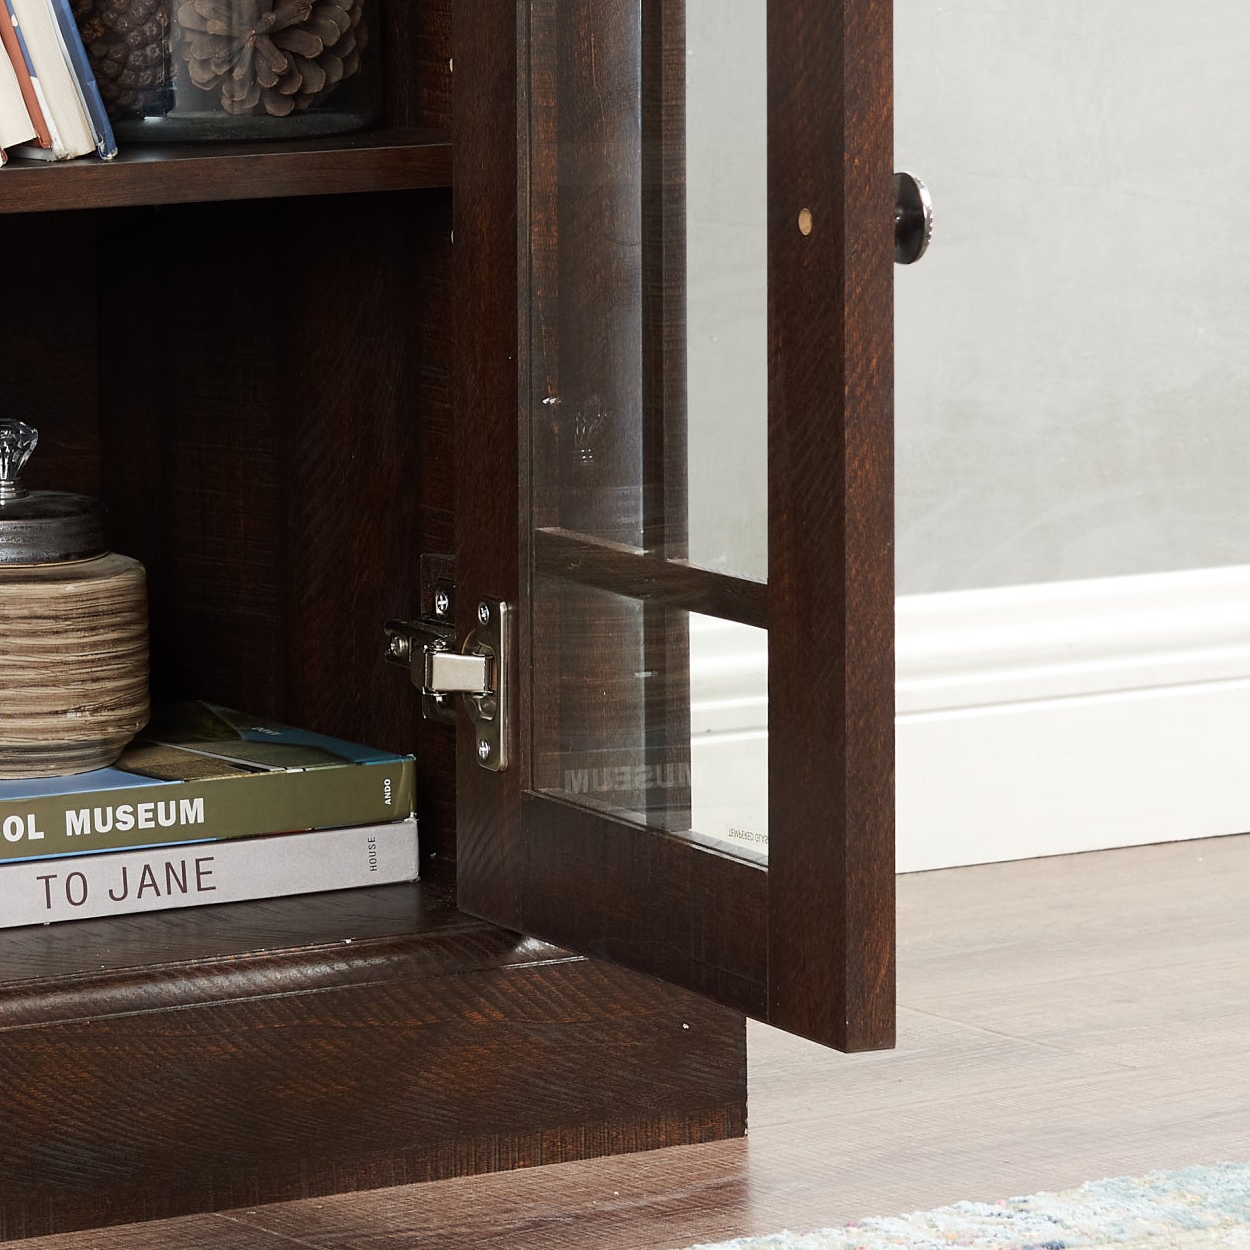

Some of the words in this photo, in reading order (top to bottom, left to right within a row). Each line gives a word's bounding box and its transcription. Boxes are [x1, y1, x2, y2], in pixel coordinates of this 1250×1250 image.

[383, 778, 392, 805] ANDO
[65, 797, 206, 837] MUSEUM
[367, 836, 378, 872] HOUSE
[36, 871, 89, 910] TO
[107, 856, 218, 903] JANE
